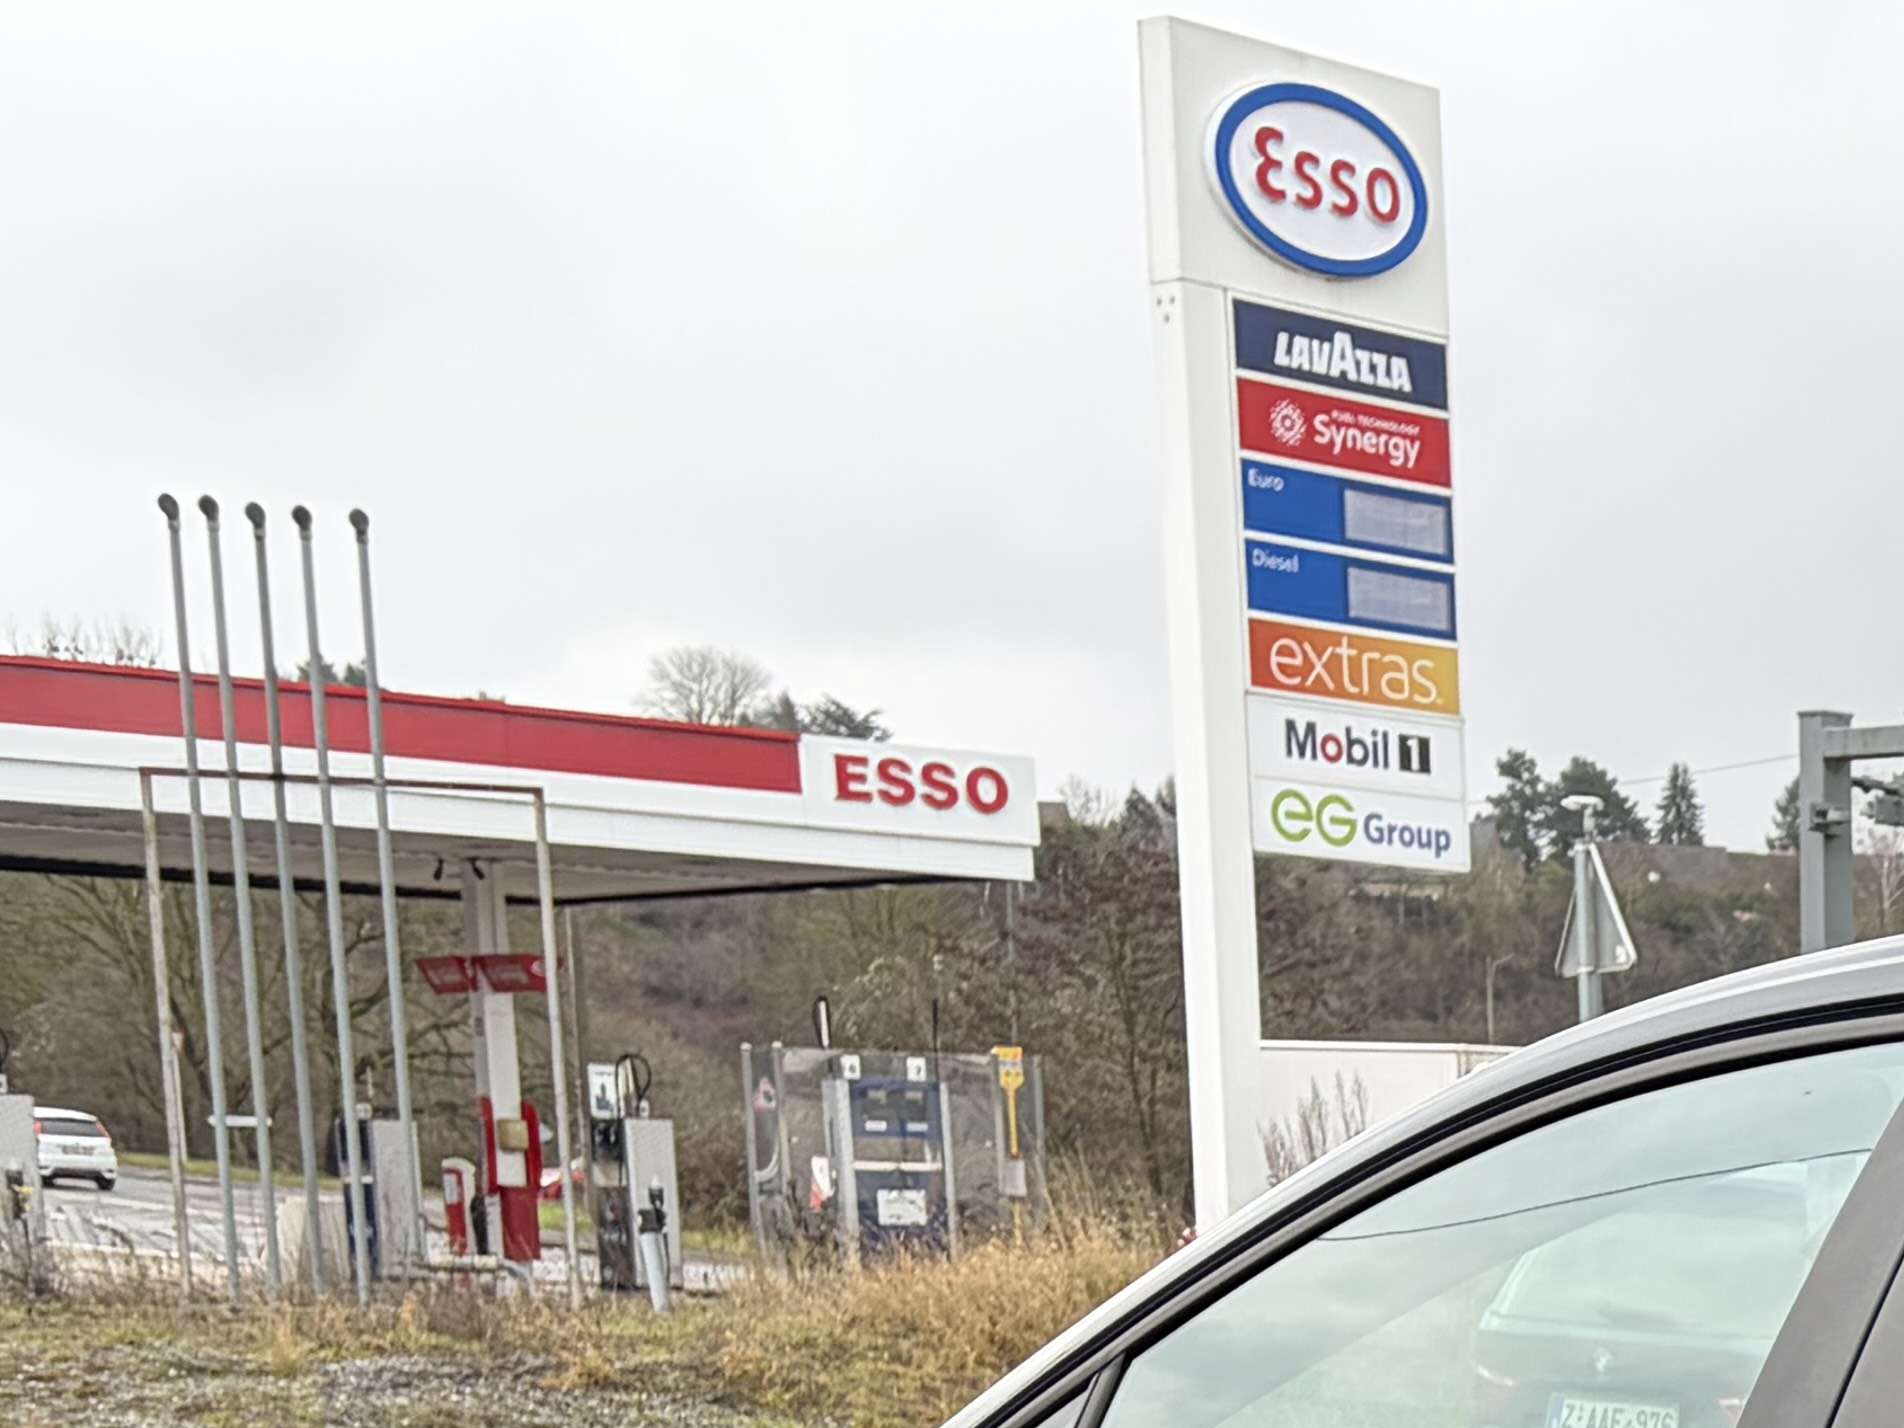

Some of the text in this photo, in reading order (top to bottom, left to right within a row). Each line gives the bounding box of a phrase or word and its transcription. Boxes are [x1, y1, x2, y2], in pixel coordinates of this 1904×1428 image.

[1273, 331, 1413, 392] LAVAZZA
[1312, 413, 1421, 469] Synergy
[1247, 467, 1285, 492] Euro
[1252, 547, 1299, 573] Diesel
[1269, 636, 1439, 705] extras
[1285, 718, 1427, 773] Mobil 1
[834, 753, 1009, 815] ESSO
[1363, 812, 1451, 858] Group
